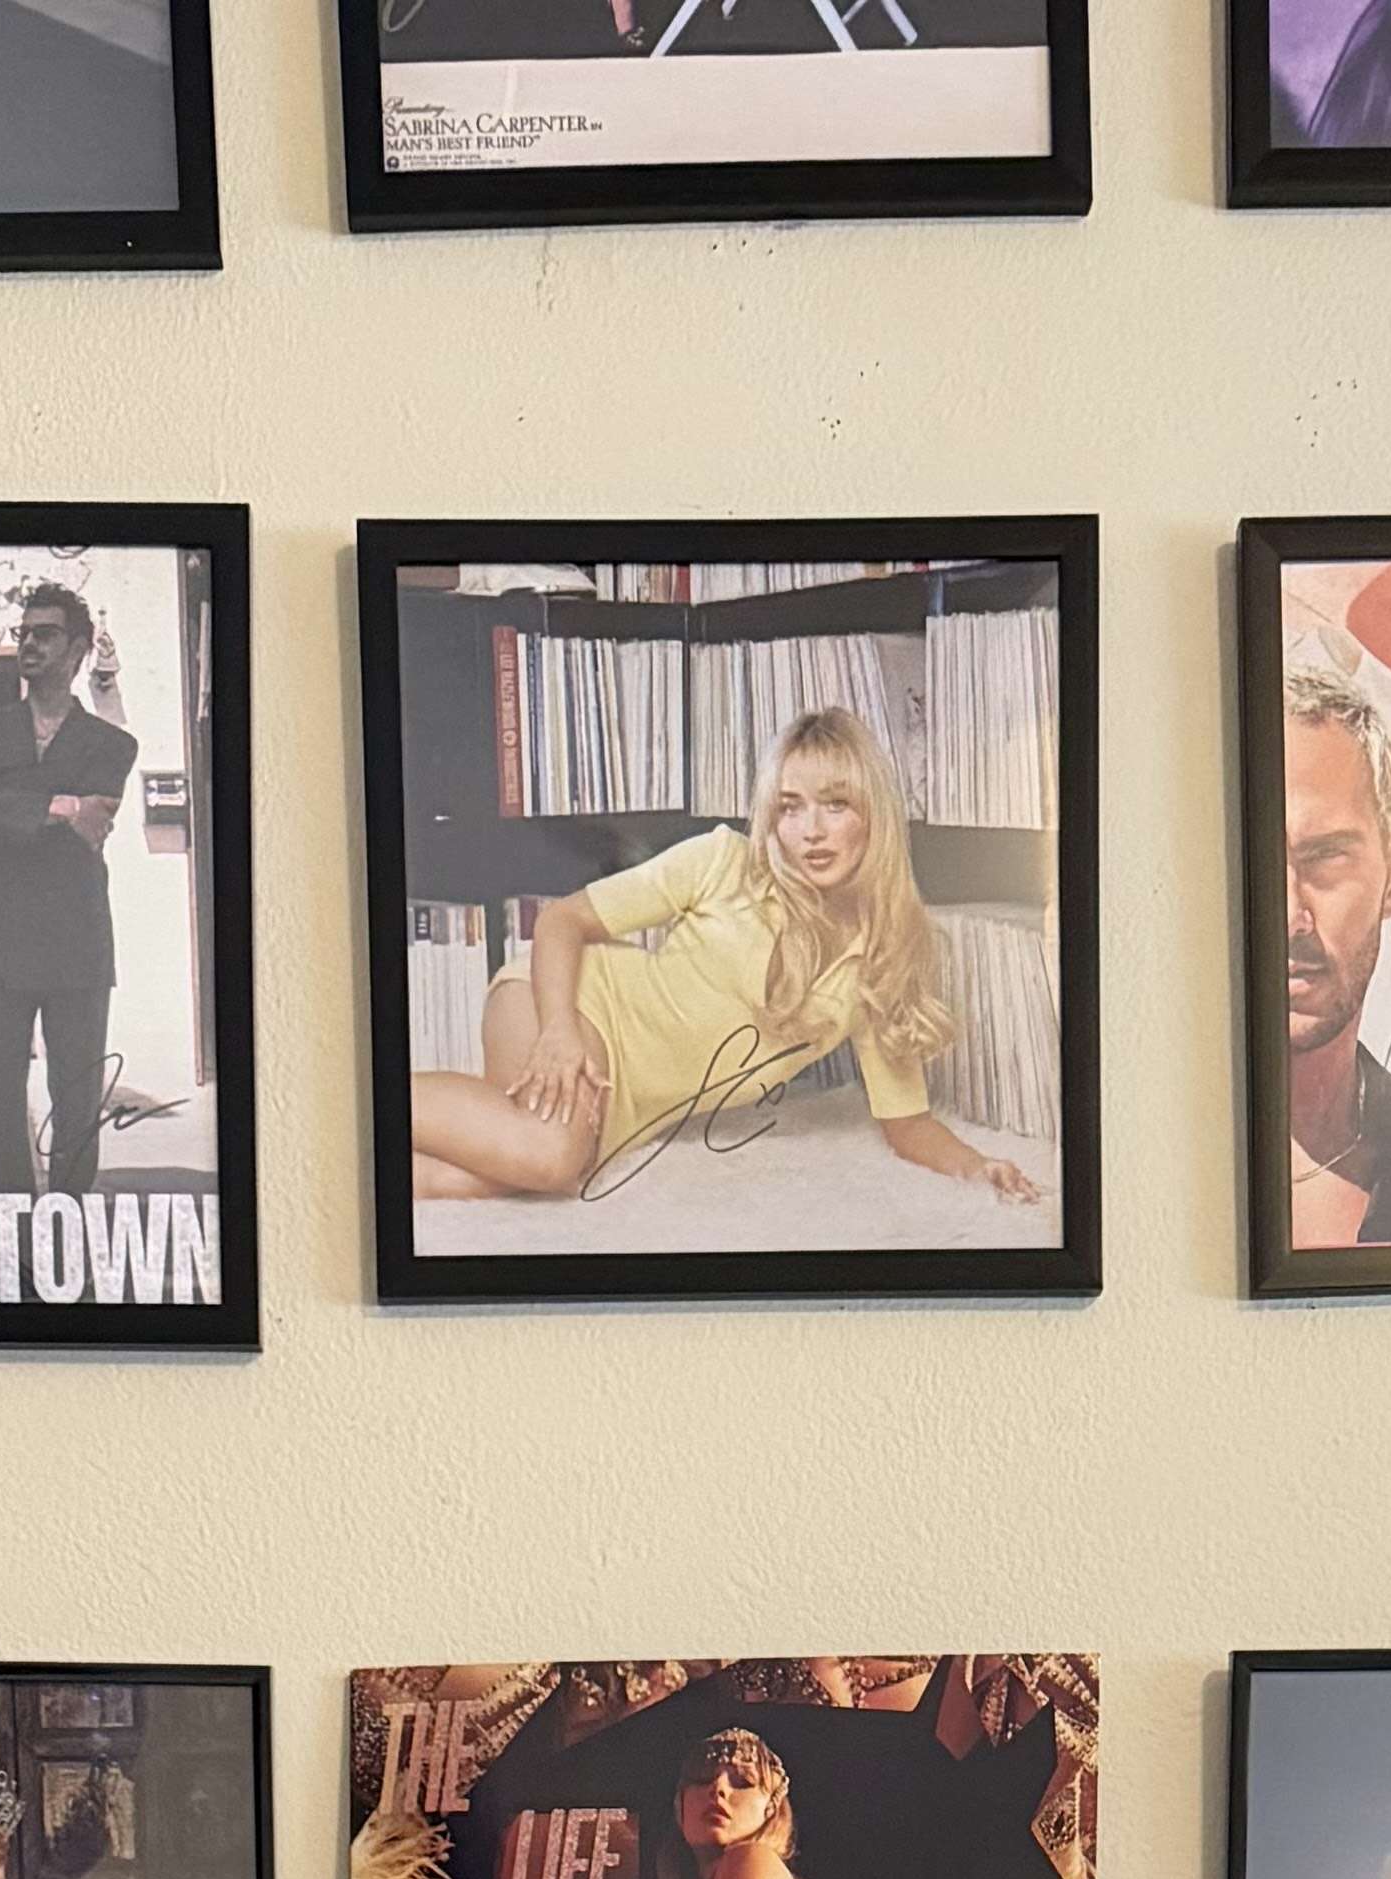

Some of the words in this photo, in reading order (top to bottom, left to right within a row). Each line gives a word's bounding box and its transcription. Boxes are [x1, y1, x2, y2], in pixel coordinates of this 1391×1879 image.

[384, 116, 473, 137] SABRINA
[476, 113, 588, 134] CARPENTER
[437, 136, 472, 151] BEST
[380, 1698, 479, 1815] THE
